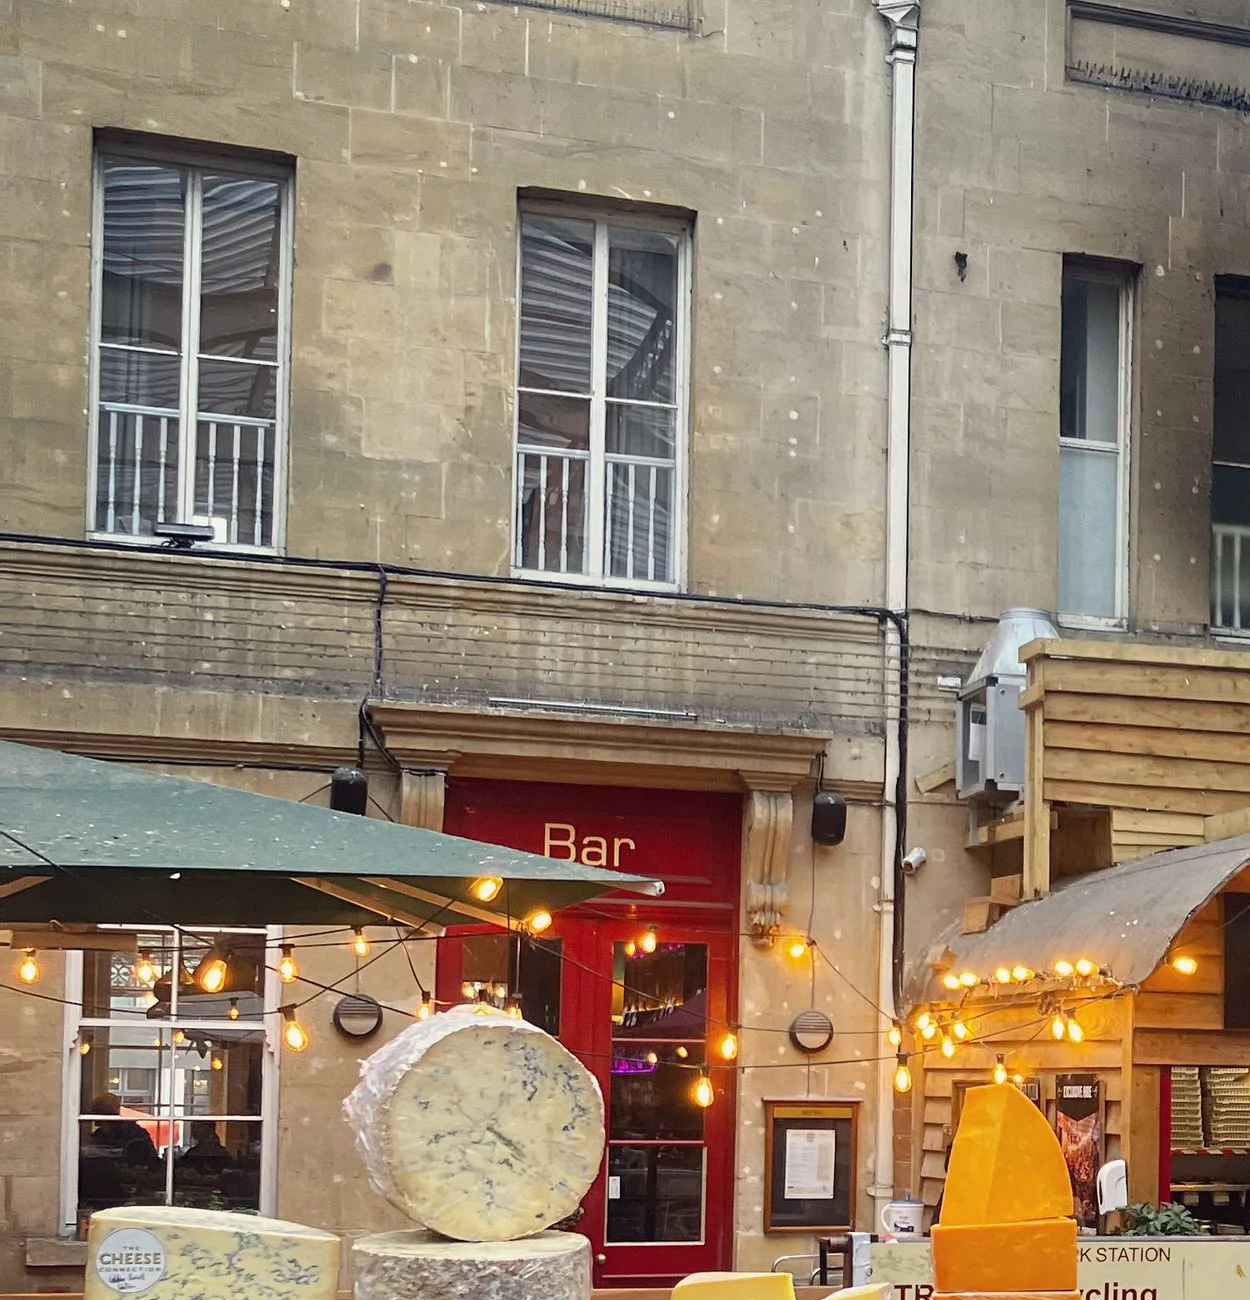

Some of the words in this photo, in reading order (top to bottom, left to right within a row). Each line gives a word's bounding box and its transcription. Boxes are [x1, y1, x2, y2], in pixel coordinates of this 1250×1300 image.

[544, 823, 635, 867] Bar
[99, 1252, 162, 1265] CHEESE
[1096, 1247, 1171, 1262] STATION
